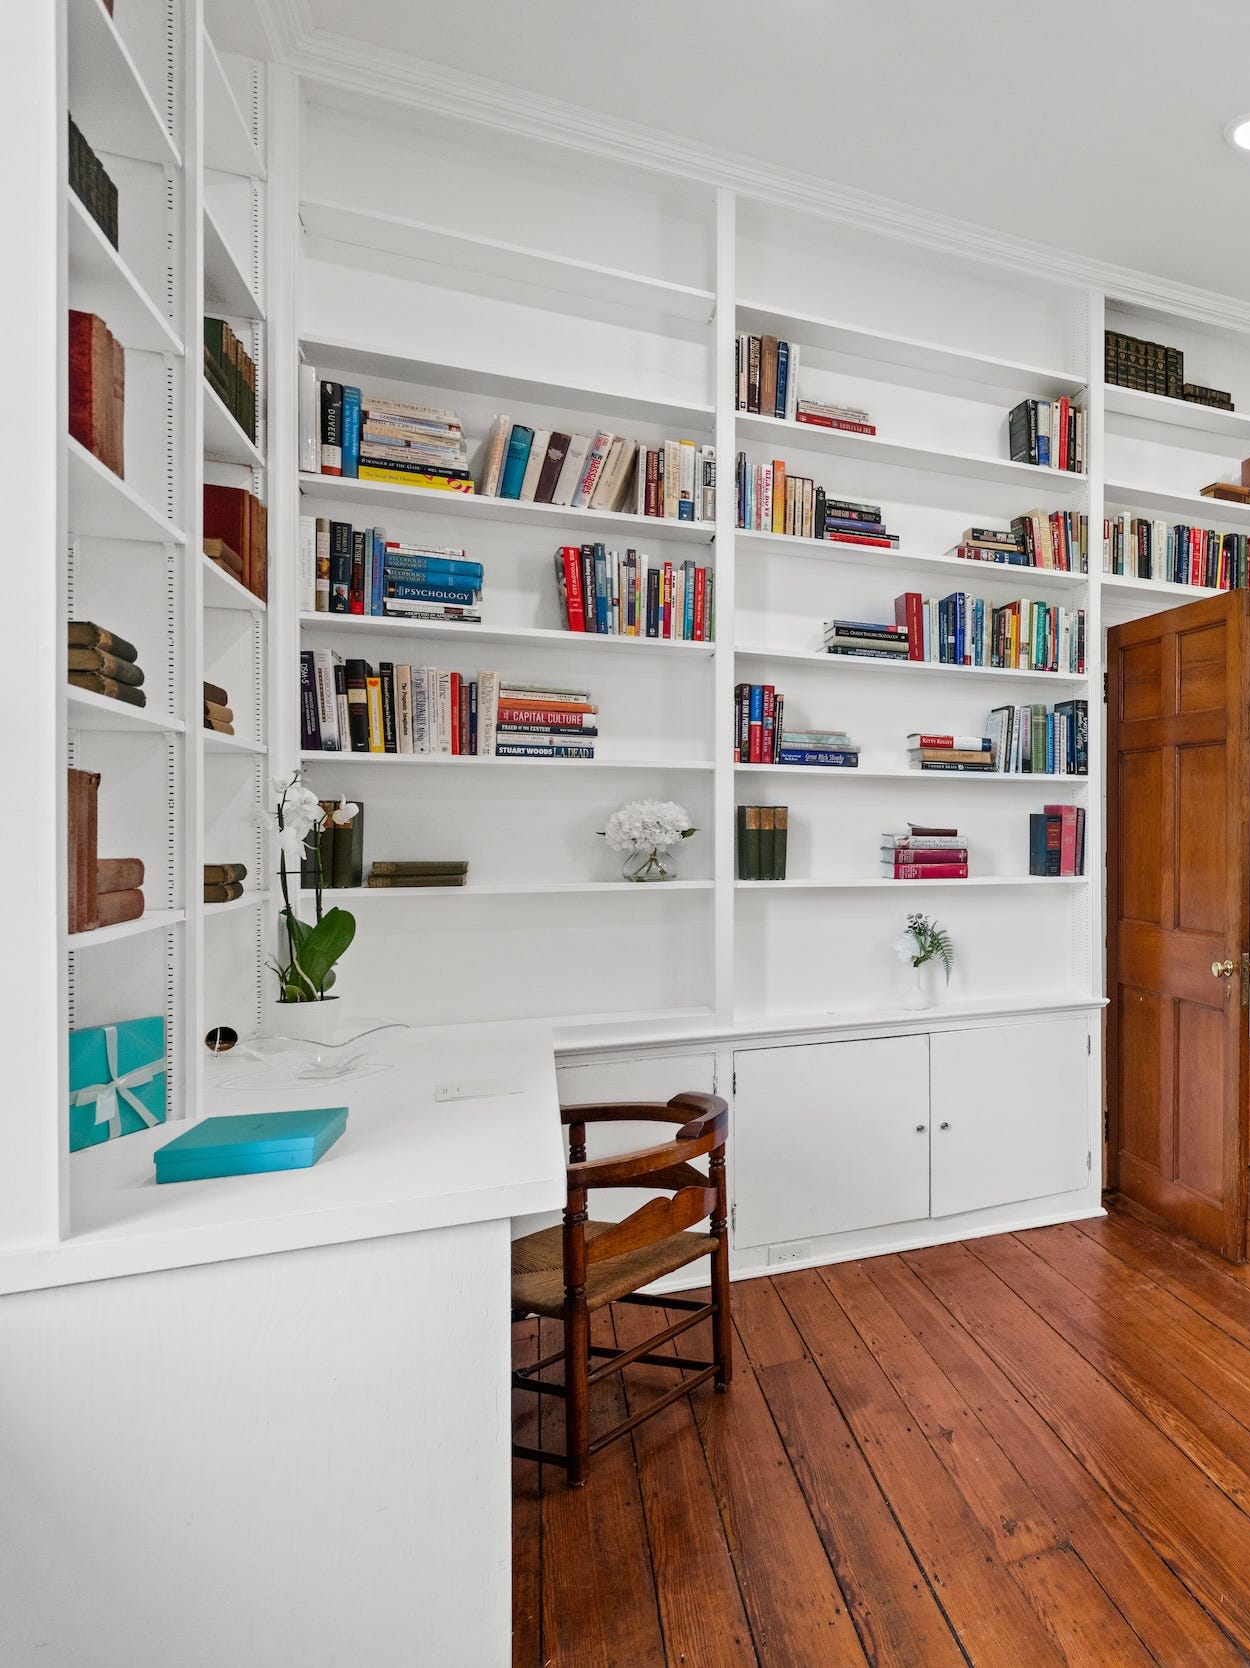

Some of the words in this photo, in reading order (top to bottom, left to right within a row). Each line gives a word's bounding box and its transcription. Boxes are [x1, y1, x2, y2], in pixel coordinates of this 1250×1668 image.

[581, 459, 601, 496] passages
[354, 545, 362, 564] RUSSERT
[404, 587, 469, 600] PSYCHOLOGY
[300, 663, 309, 684] DSM-5
[323, 667, 331, 697] HANDBOOK
[485, 672, 493, 680] The
[438, 673, 448, 698] Maine
[485, 682, 493, 710] Duchess
[415, 690, 426, 726] MILLIONAIRE
[513, 711, 544, 722] CAPITAL
[547, 713, 581, 724] CULTURE
[416, 727, 424, 740] MIND
[567, 748, 587, 757] DEAD
[829, 753, 844, 764] Slowly
